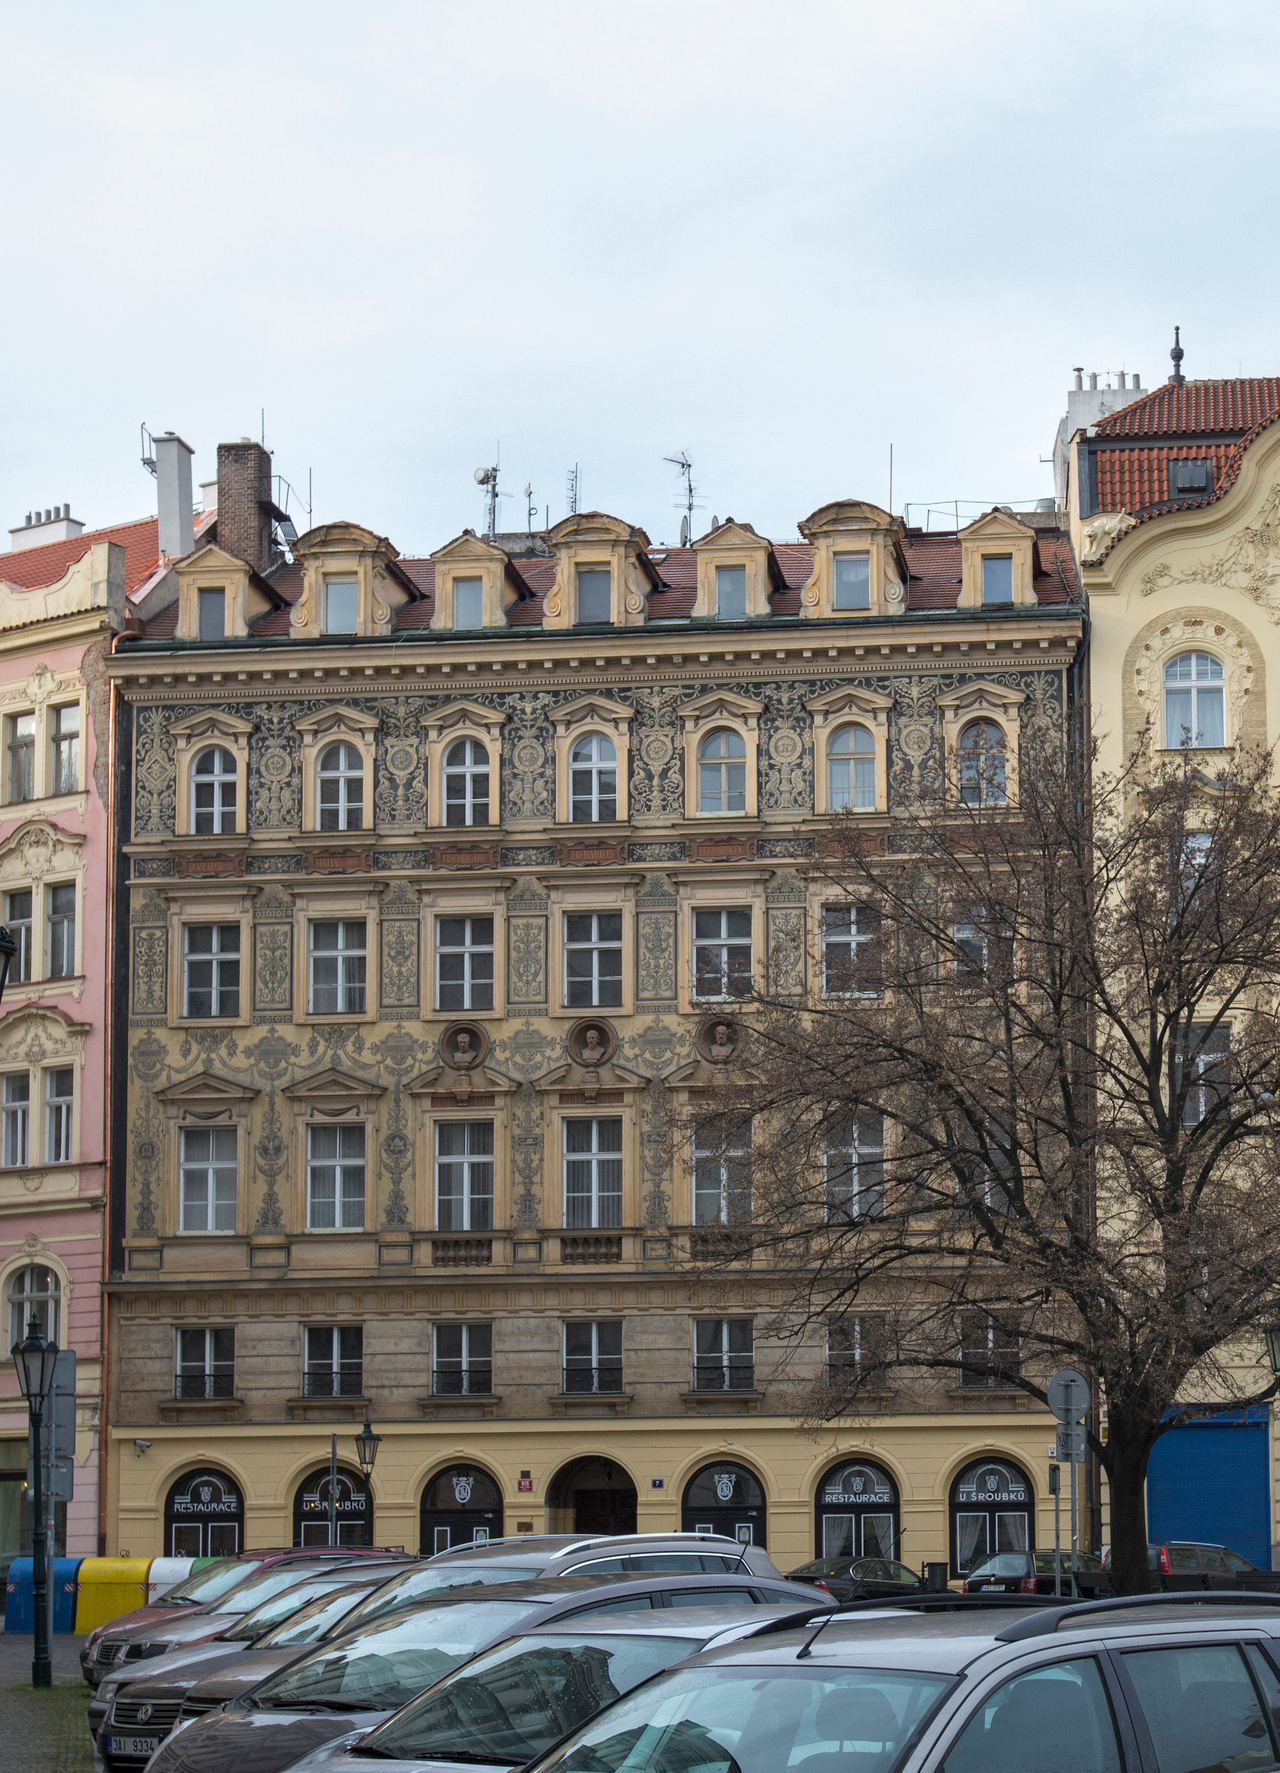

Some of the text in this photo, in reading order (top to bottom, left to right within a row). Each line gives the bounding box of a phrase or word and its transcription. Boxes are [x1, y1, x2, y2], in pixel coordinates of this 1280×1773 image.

[825, 1494, 890, 1503] RESTAURACE
[960, 1490, 1025, 1501] U ŠROUBKŮ
[174, 1502, 237, 1512] RESTAURACE
[303, 1500, 366, 1511] U ŠRUBKŮ
[133, 1739, 154, 1753] 9334
